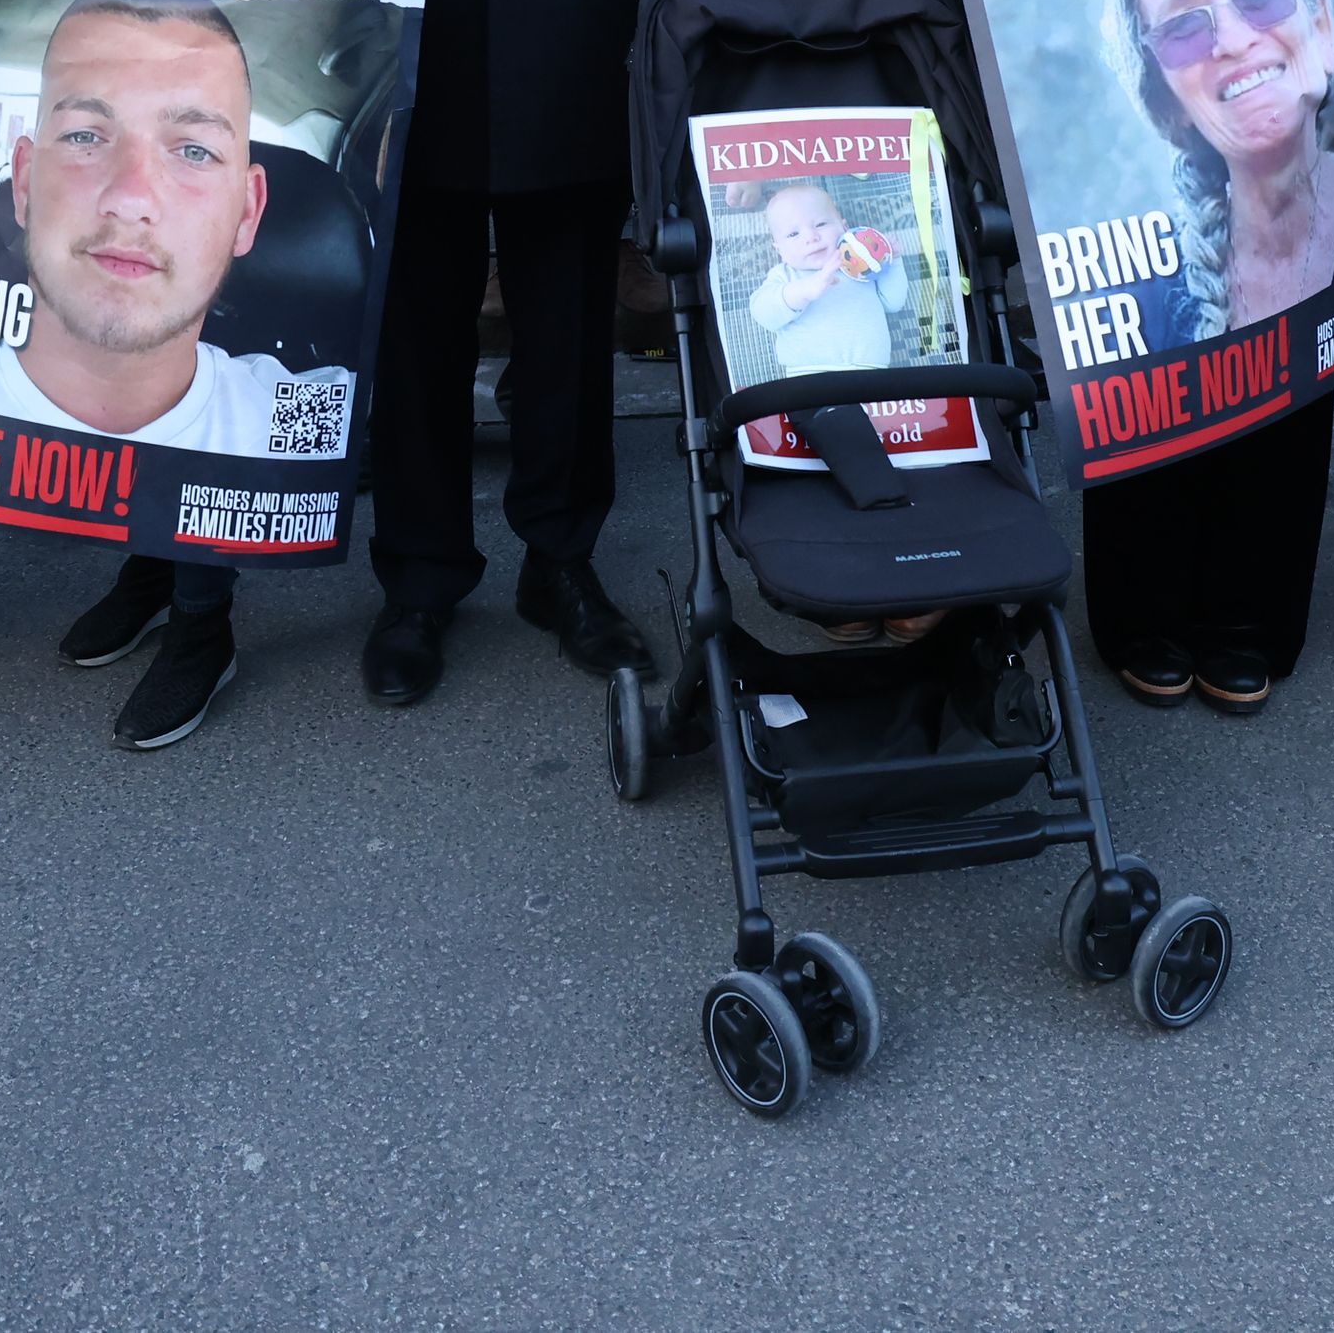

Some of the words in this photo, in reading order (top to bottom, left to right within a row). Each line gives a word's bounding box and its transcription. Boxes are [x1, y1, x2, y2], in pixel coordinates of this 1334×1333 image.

[1037, 210, 1179, 299] BRING
[1053, 292, 1149, 371] HER
[1071, 360, 1191, 450] HOME
[1199, 315, 1291, 418] NOW!
[785, 432, 798, 450] 9
[889, 422, 923, 445] old
[9, 433, 139, 517] NOW!
[181, 483, 249, 511] HOSTAGES
[250, 488, 280, 513] AND
[282, 491, 339, 514] MISSING
[177, 505, 267, 543] FAMILIES
[269, 512, 337, 543] FORUM
[895, 550, 961, 562] MAXI-COSI
